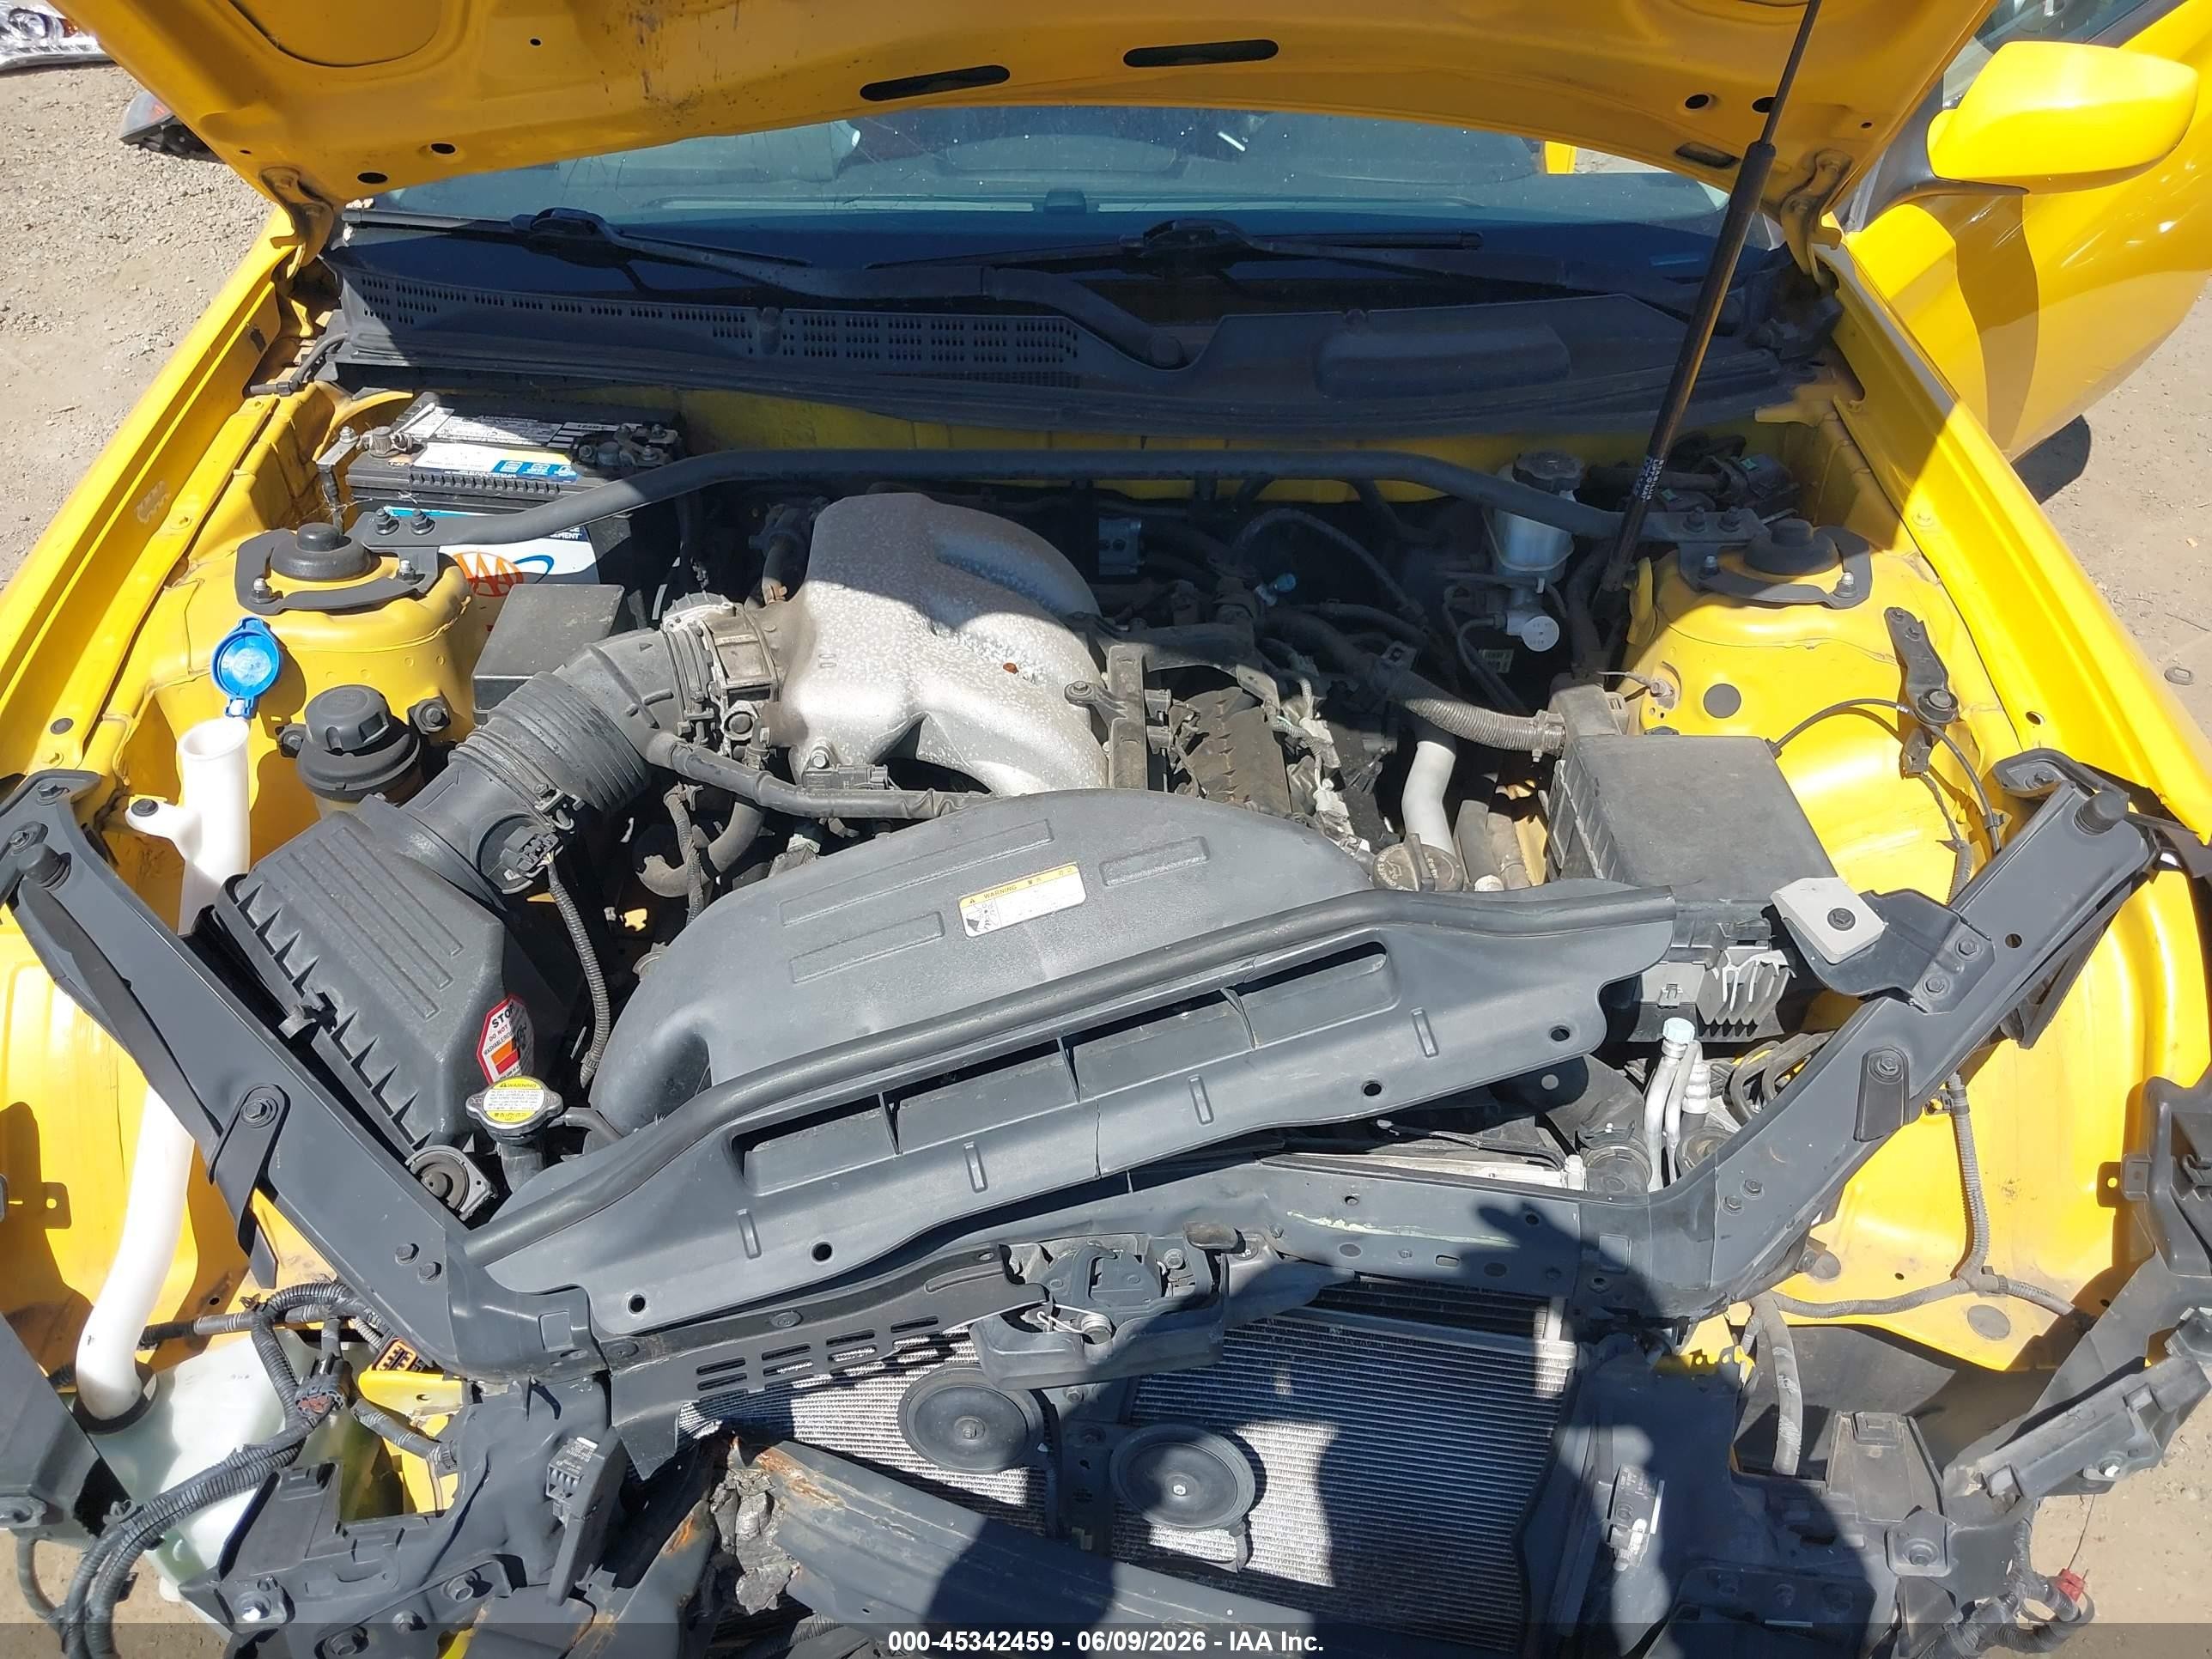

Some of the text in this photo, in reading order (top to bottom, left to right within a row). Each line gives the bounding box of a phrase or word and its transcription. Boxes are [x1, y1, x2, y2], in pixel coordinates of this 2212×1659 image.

[983, 884, 1018, 899] WARNING
[489, 1024, 508, 1042] DO NOT
